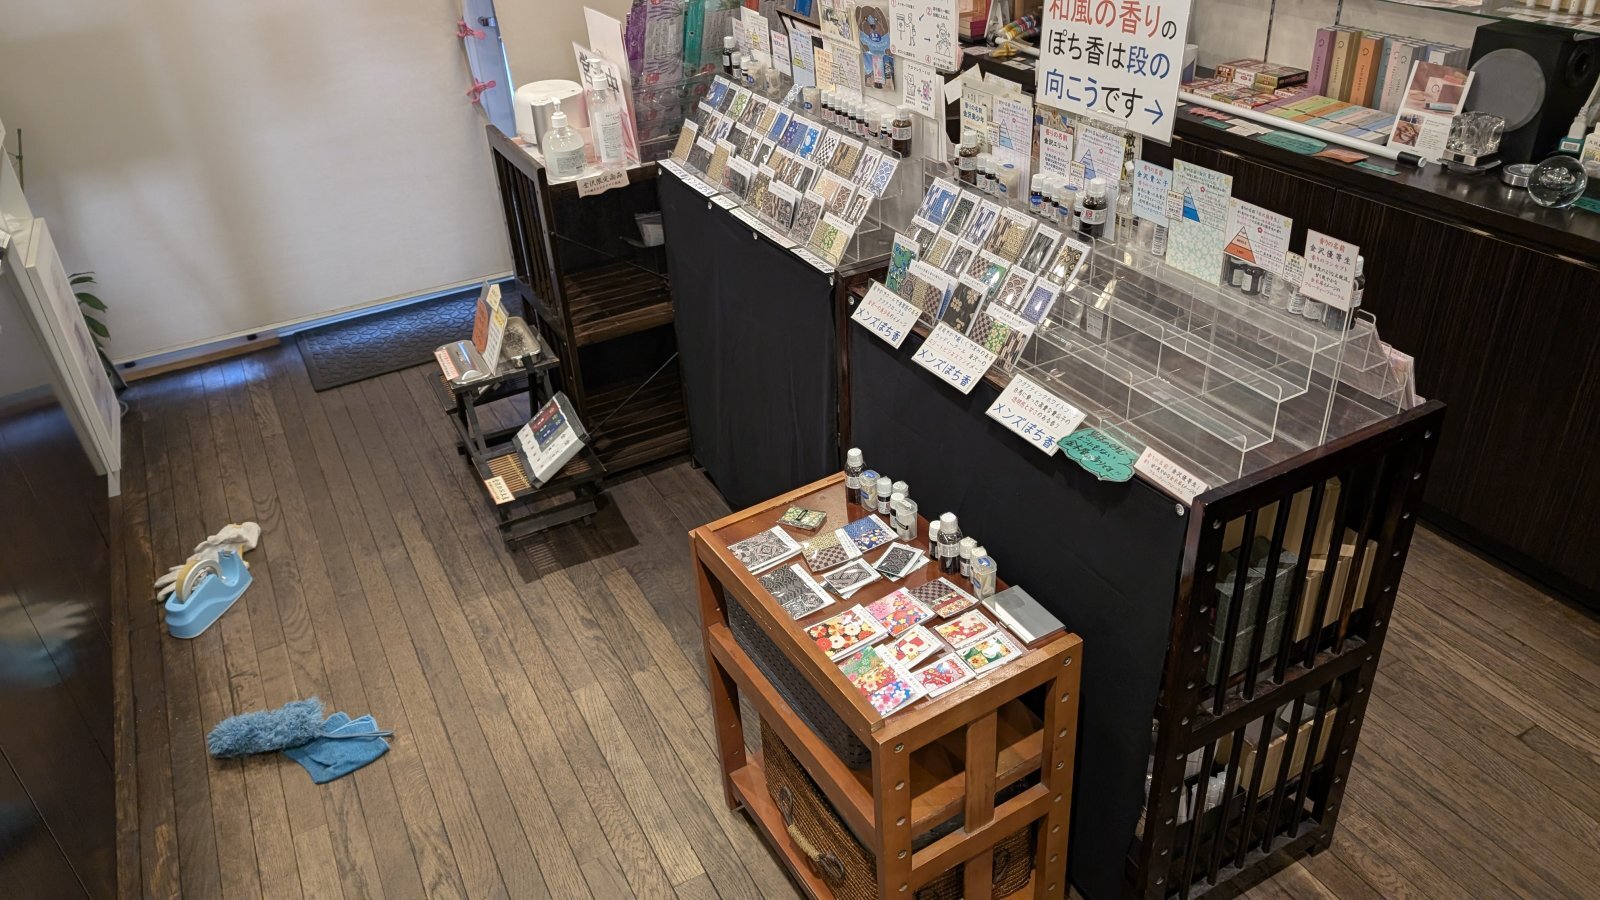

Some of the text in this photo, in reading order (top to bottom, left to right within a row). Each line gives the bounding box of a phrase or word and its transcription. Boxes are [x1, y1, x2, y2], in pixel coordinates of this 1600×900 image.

[1049, 0, 1177, 39] 和風の香りの
[1048, 29, 1170, 79] ぽち香は段の
[1044, 68, 1143, 118] 向こうです
[1044, 138, 1068, 150] 金沢エリート
[1045, 128, 1068, 142] 香りの名前
[1137, 170, 1168, 187] 金沢貴公子
[1144, 164, 1164, 177] 香りの名前
[1310, 244, 1350, 266] 金沢優等生
[1320, 238, 1346, 253] 香りの名前
[856, 307, 901, 342] メンズぽち香
[918, 349, 972, 387] メンズぽち香
[993, 403, 1056, 450] メンズぽち香
